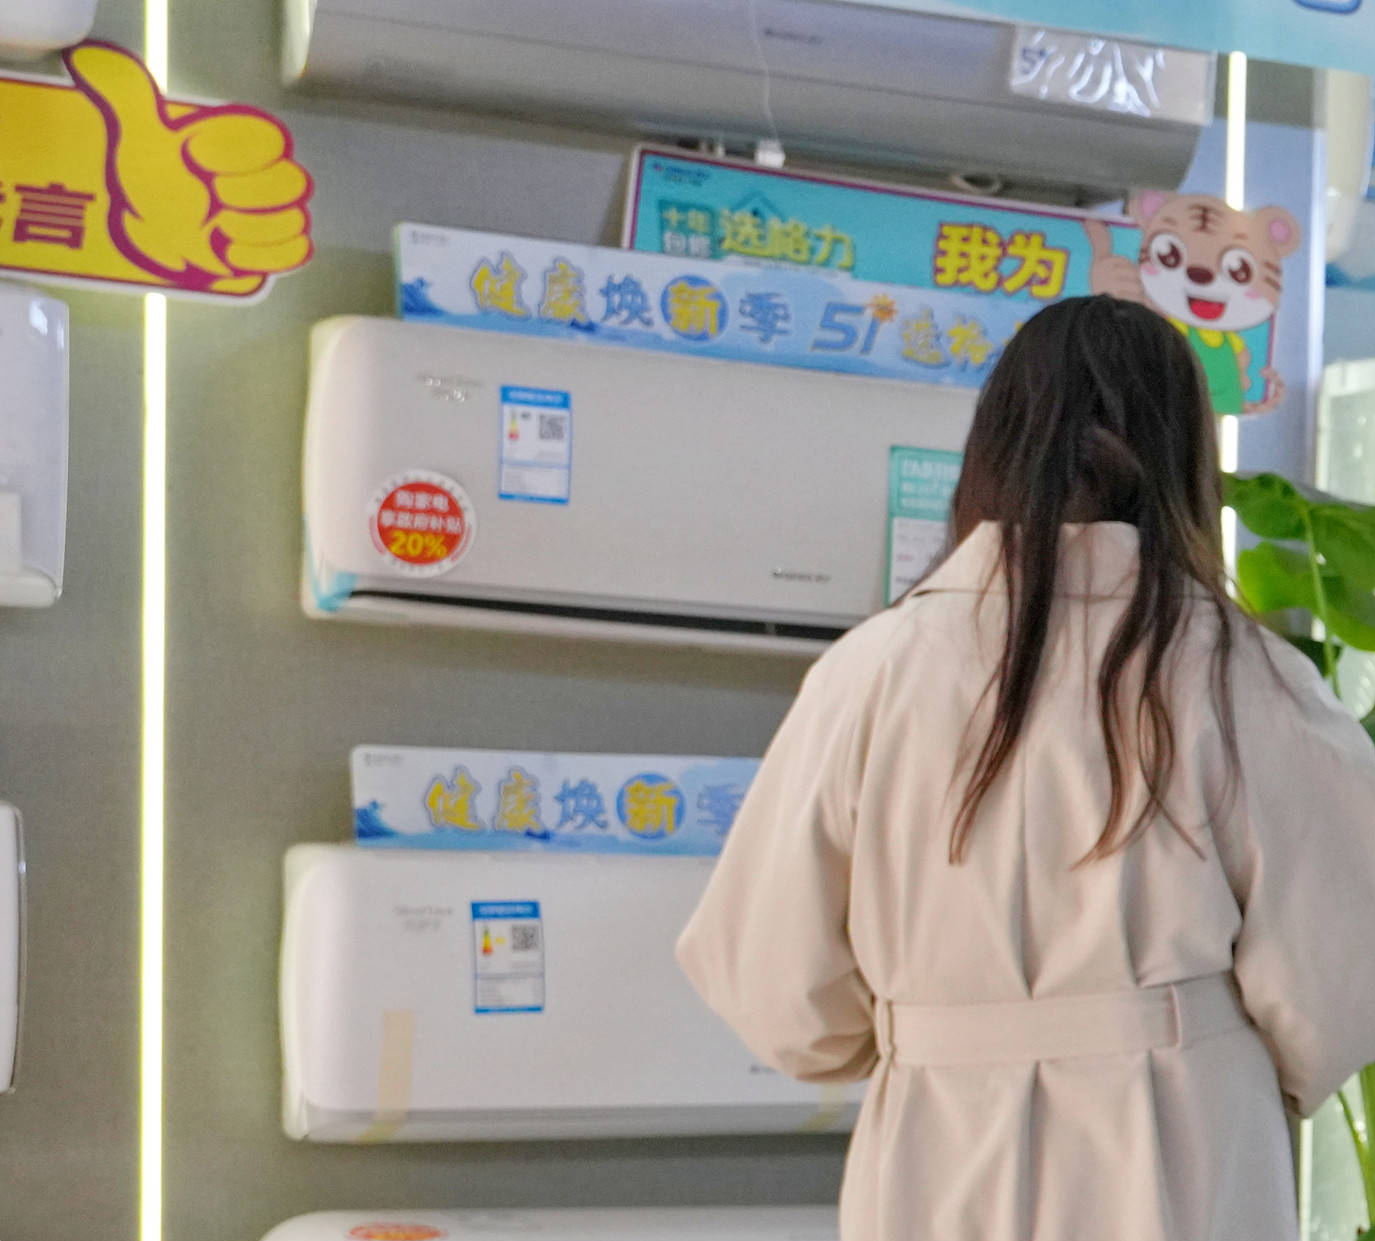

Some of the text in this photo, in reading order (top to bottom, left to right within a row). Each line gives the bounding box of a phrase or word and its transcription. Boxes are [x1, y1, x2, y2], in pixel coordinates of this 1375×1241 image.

[0, 182, 97, 251] 言
[933, 221, 1071, 299] 我为
[389, 530, 448, 558] 20%
